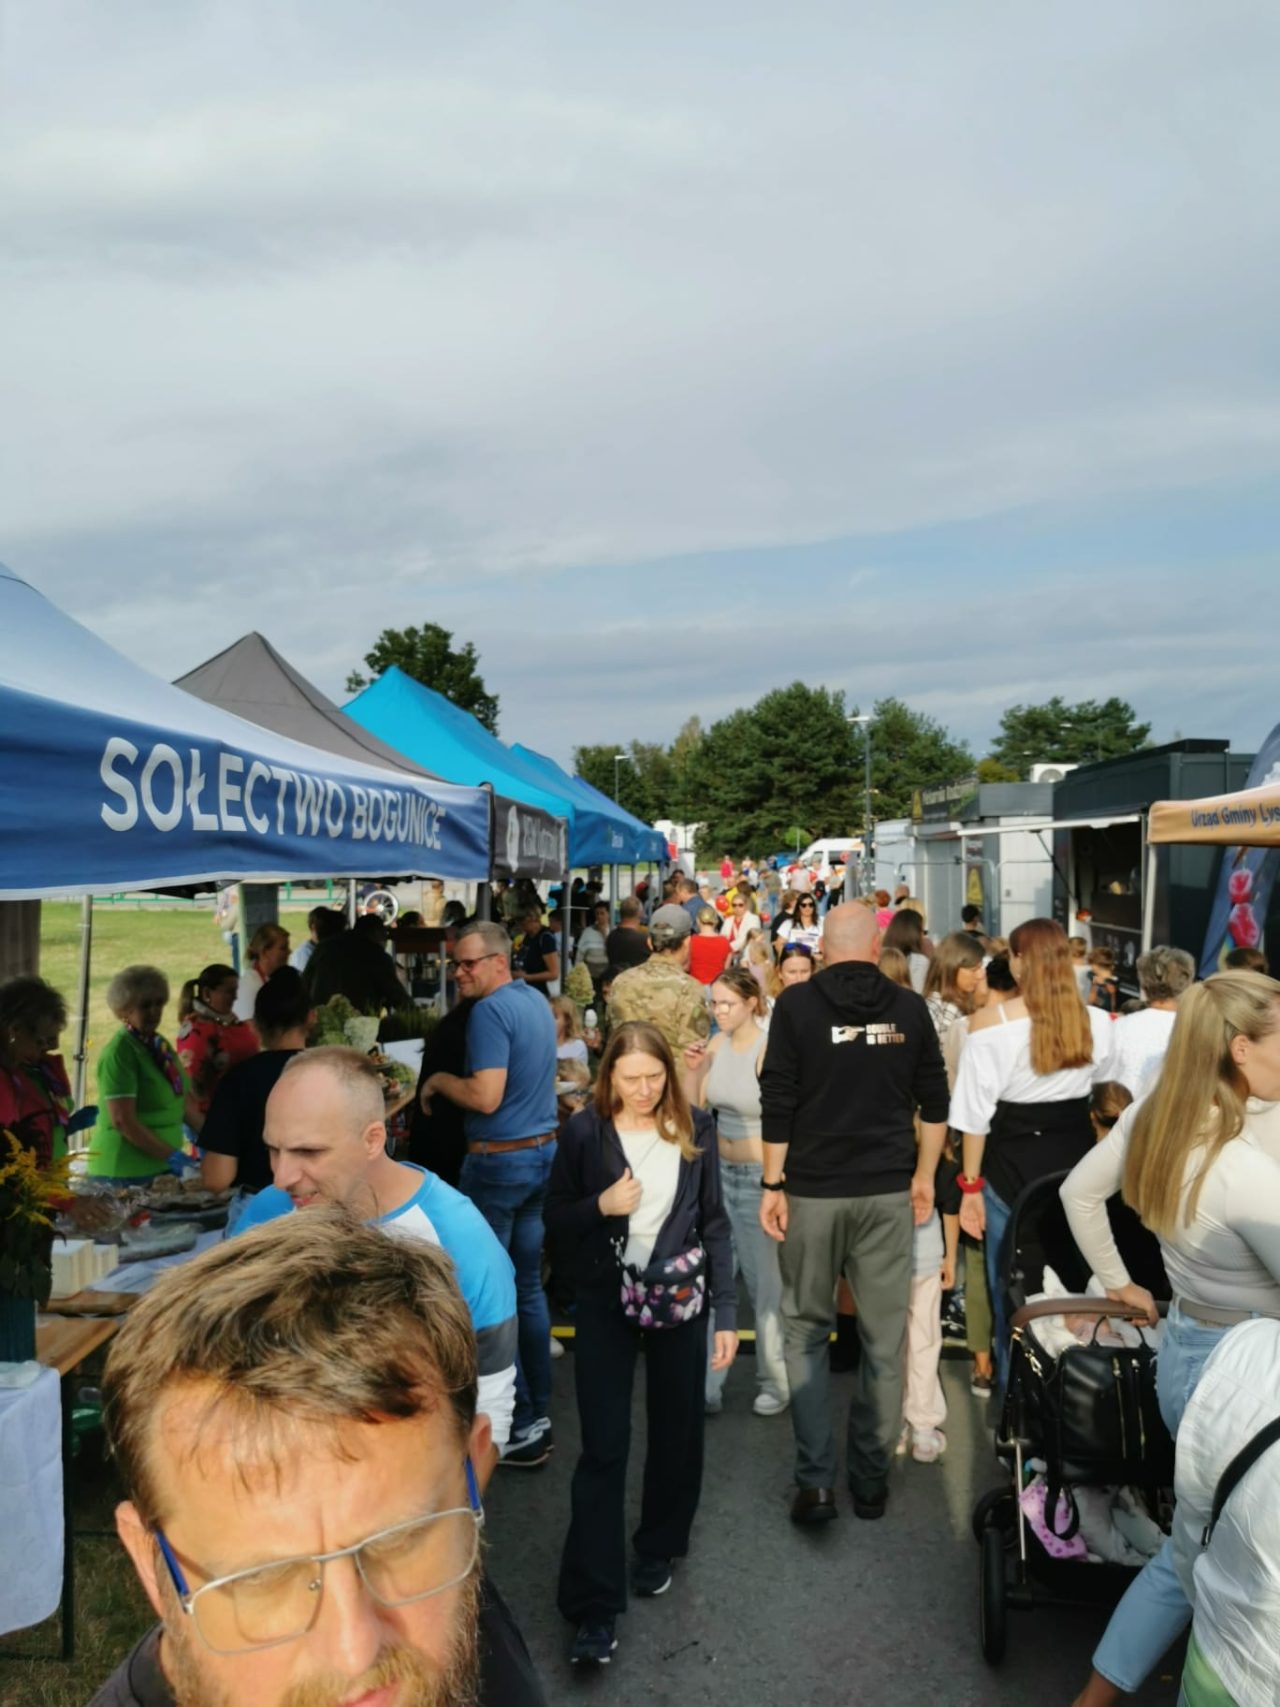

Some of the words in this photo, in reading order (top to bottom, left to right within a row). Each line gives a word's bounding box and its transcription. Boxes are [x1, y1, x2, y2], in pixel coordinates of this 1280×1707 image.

[100, 736, 347, 839] SOŁECTWO
[349, 784, 446, 850] BOGUNICE
[1221, 806, 1257, 828] Gminy
